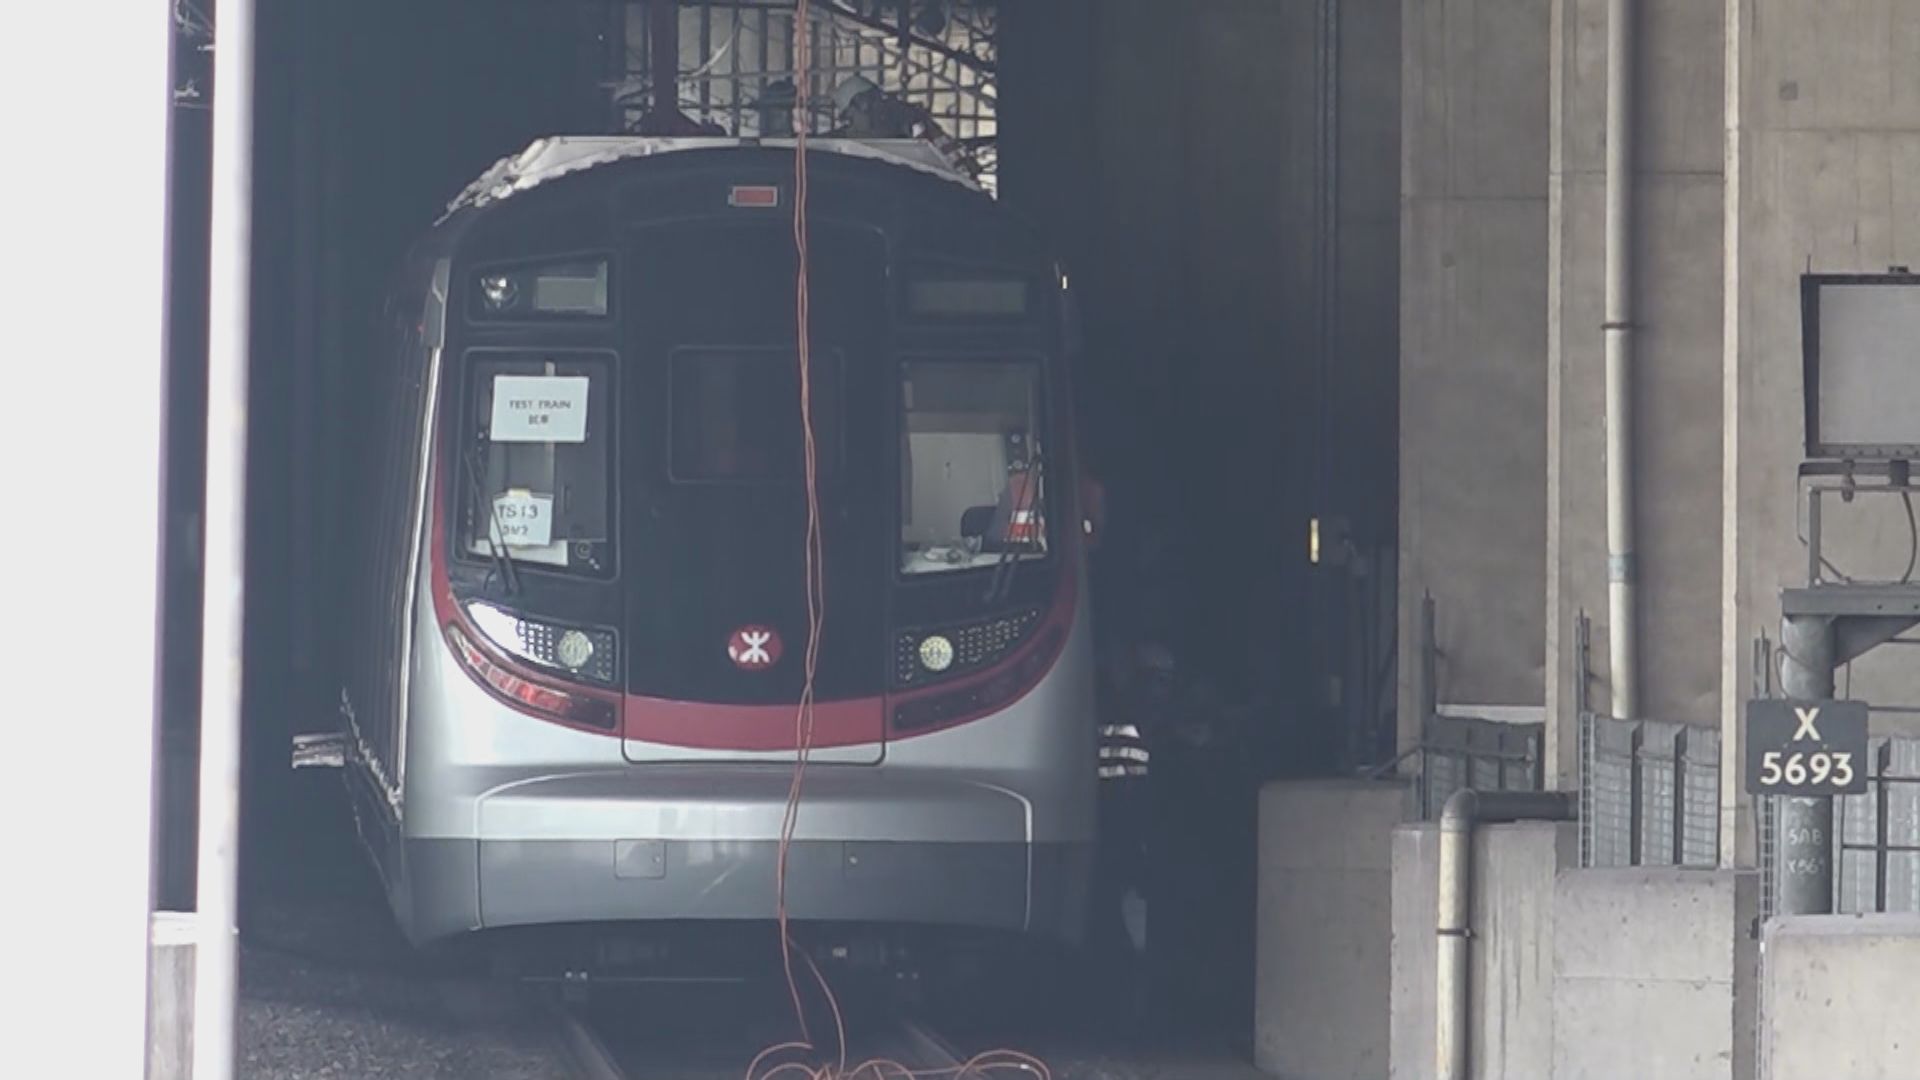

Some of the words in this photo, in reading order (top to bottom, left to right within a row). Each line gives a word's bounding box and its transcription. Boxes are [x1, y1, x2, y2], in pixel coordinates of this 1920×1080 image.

[509, 400, 533, 409] TEST
[538, 400, 572, 409] TRAIN
[1793, 708, 1821, 741] X
[1760, 752, 1853, 786] 5693
